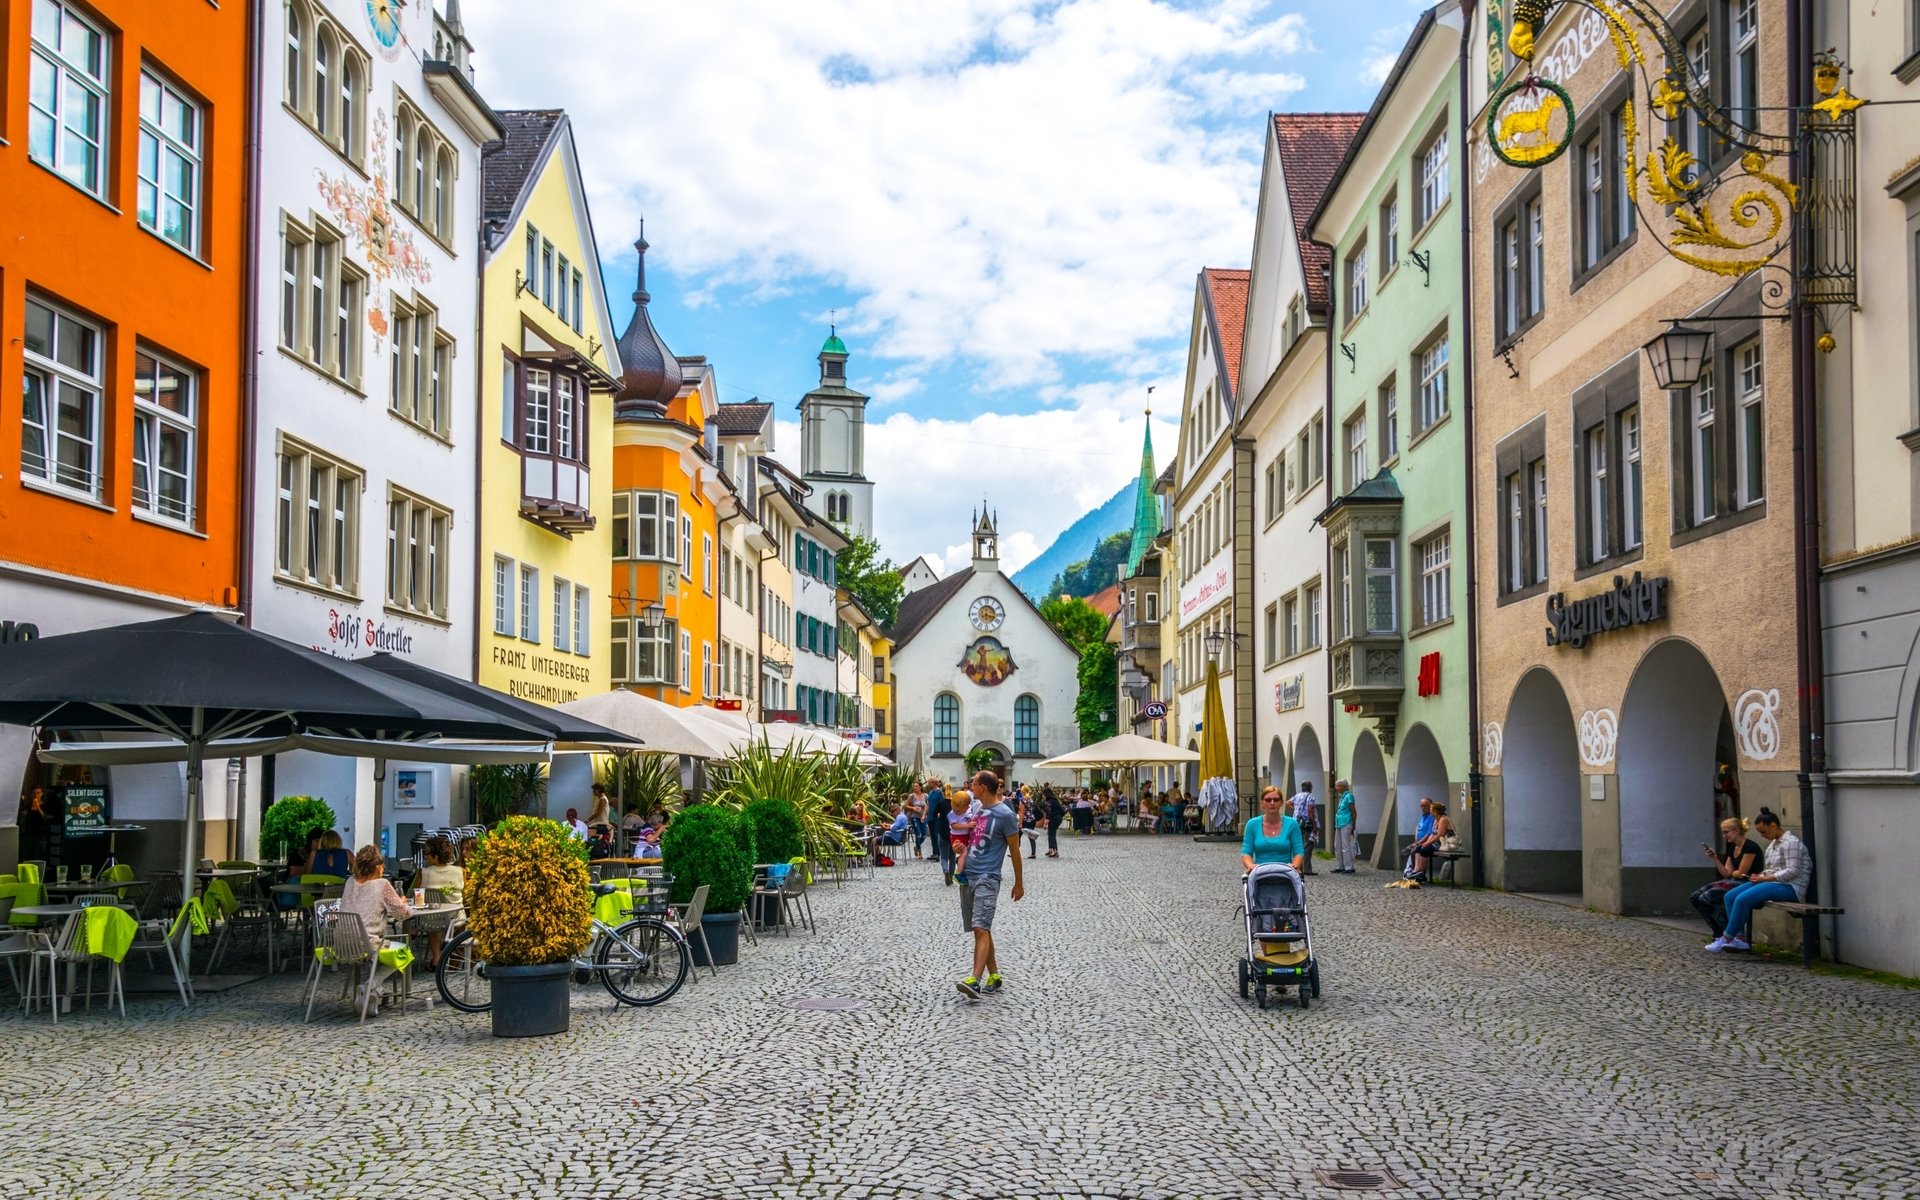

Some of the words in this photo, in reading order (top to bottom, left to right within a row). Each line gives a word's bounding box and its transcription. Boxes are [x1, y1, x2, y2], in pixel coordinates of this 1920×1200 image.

[1545, 571, 1668, 649] Sagmeister
[328, 608, 361, 649] Josef
[365, 618, 413, 654] Schertler
[493, 646, 526, 669] FRANZ
[531, 655, 590, 683] UNTERBERGER
[509, 679, 578, 704] BUCHHANDLUNG
[1147, 705, 1164, 716] C&A
[68, 789, 86, 797] SILENT
